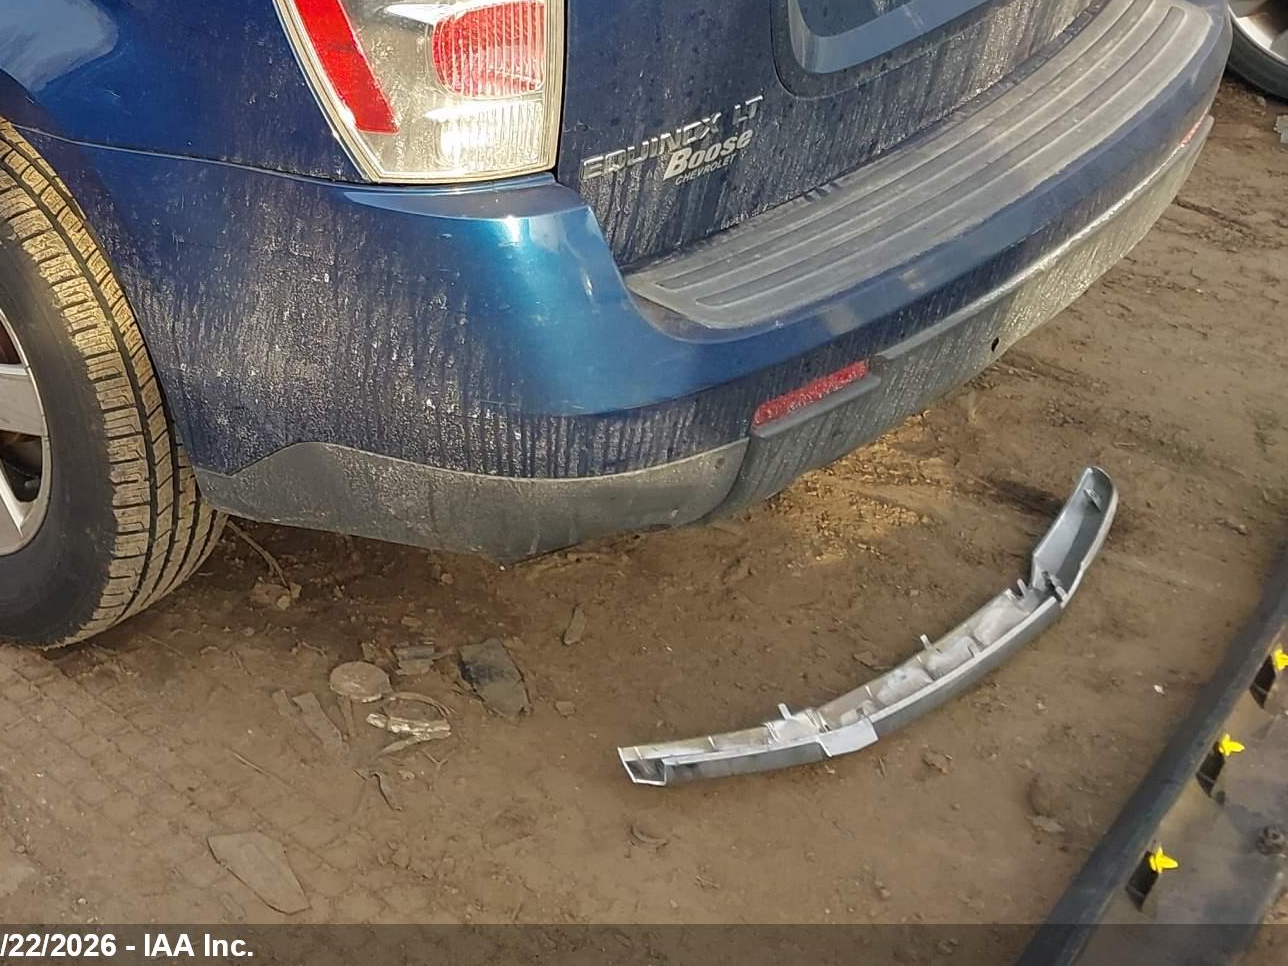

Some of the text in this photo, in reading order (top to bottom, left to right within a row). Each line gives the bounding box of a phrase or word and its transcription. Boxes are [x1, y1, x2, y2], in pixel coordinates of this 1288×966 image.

[580, 95, 764, 181] EQUINOX LT
[663, 128, 754, 181] Boose
[674, 153, 736, 186] CHEVROLET
